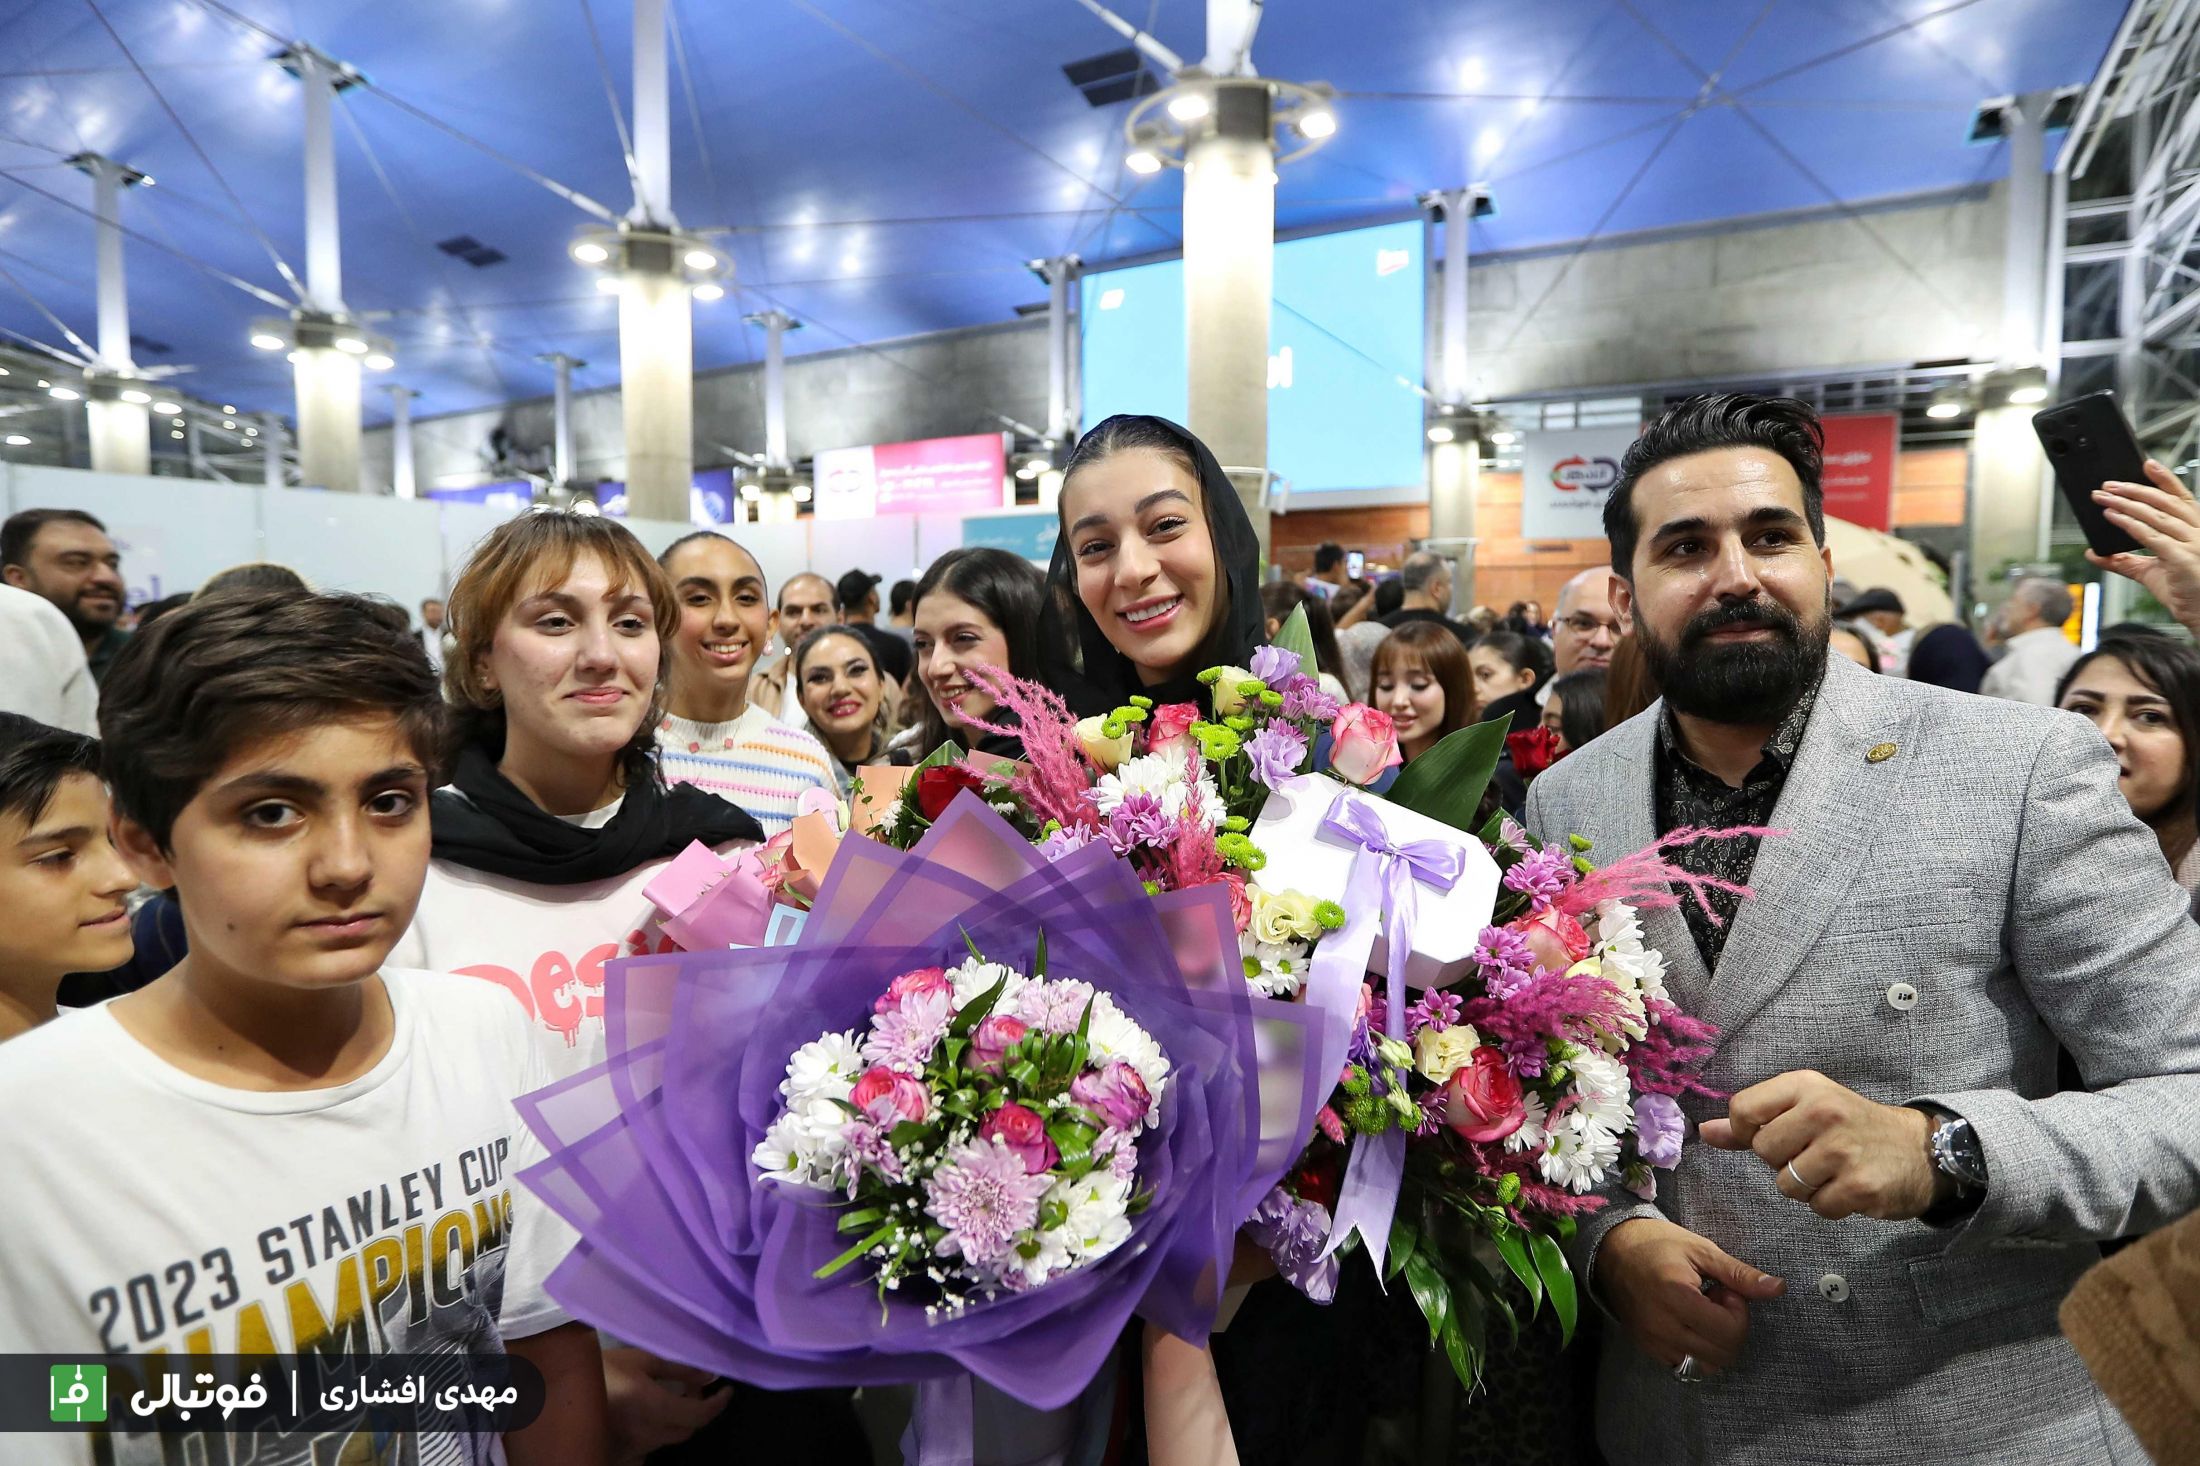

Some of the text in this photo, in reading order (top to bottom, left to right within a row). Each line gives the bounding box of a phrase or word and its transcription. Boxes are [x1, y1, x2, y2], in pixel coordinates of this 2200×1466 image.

[89, 1137, 509, 1357] 2023 STANLEY CUP
